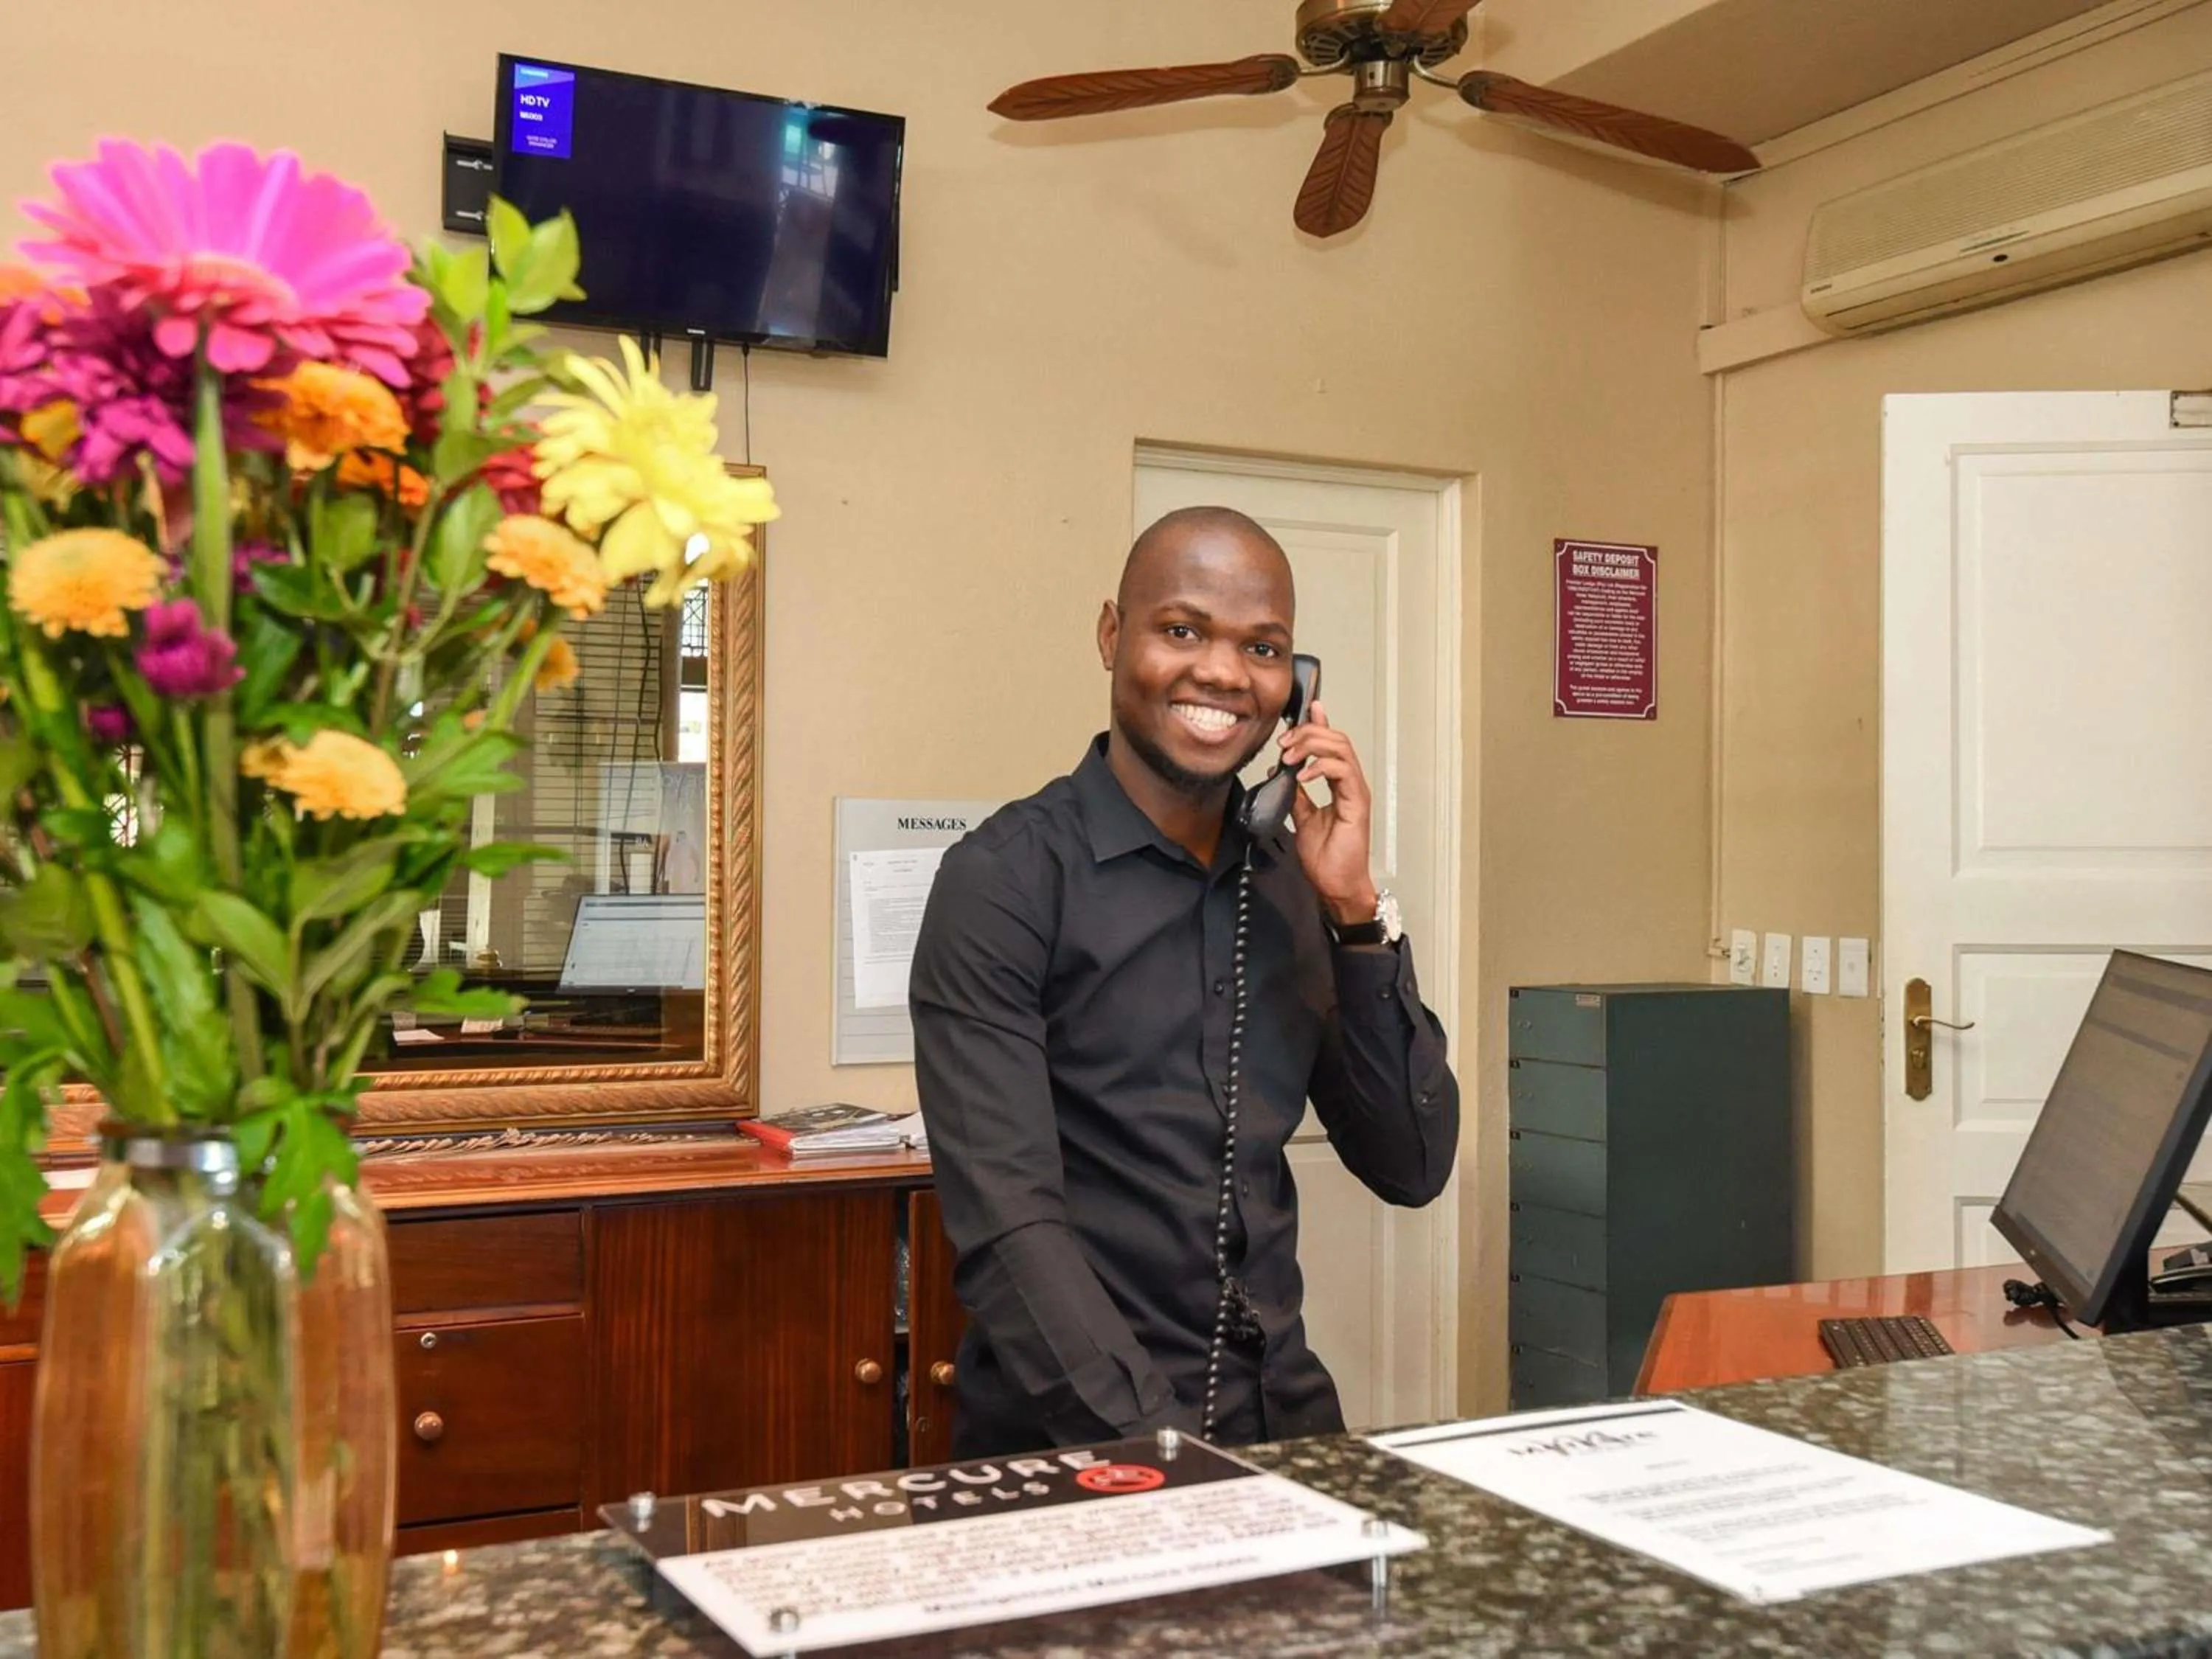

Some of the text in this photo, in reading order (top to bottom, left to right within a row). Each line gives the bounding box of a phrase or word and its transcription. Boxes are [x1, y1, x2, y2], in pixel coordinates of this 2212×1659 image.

[1573, 550, 1640, 566] SAFETY DEPOSIT
[1573, 564, 1640, 579] BOX DISCLAIMER
[897, 818, 967, 830] MESSAGES
[701, 1450, 1110, 1518] MERCURE
[829, 1481, 1050, 1522] HOTELS
